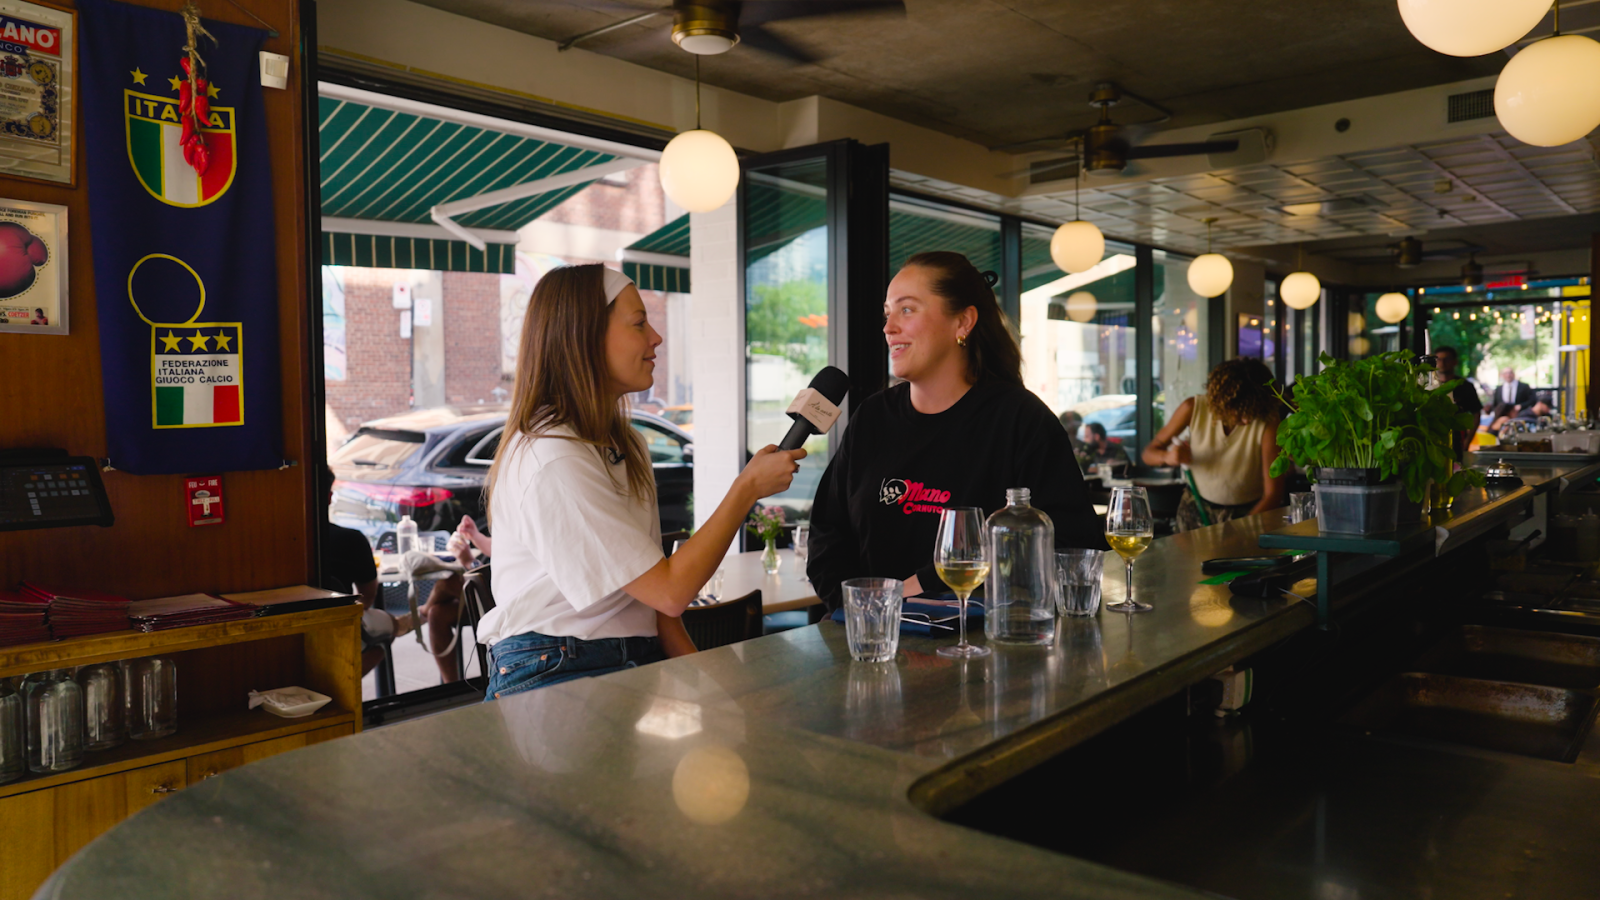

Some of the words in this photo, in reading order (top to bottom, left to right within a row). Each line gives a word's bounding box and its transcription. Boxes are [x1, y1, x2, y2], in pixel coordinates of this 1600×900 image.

[135, 98, 225, 128] ITAA
[162, 360, 229, 368] FEDERAZIONE
[158, 368, 205, 376] ITALIANA
[155, 376, 195, 384] GIUOCO
[199, 375, 233, 384] CALCIO
[898, 479, 951, 504] Mano
